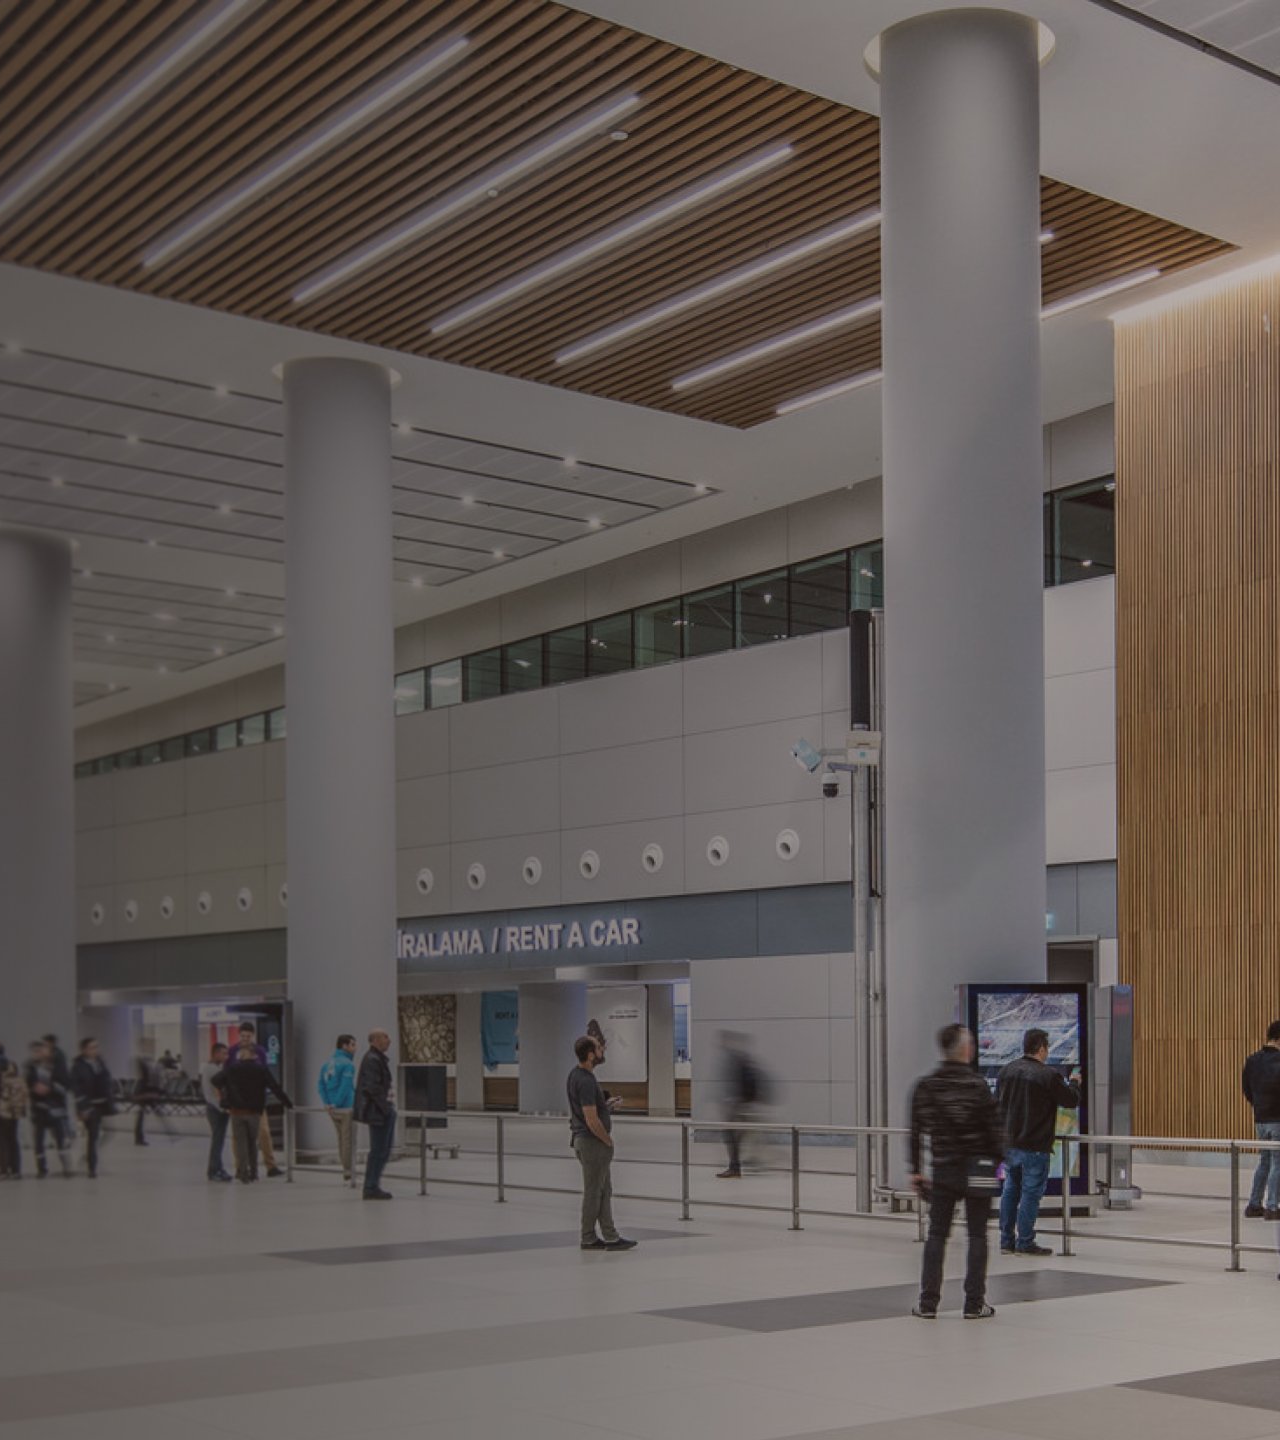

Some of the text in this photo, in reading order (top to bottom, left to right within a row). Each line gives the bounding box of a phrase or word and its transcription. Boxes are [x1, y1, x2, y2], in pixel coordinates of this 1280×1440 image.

[397, 928, 484, 958] İRALAMA
[506, 923, 563, 952] RENT
[567, 921, 585, 948] A
[589, 917, 640, 946] CAR
